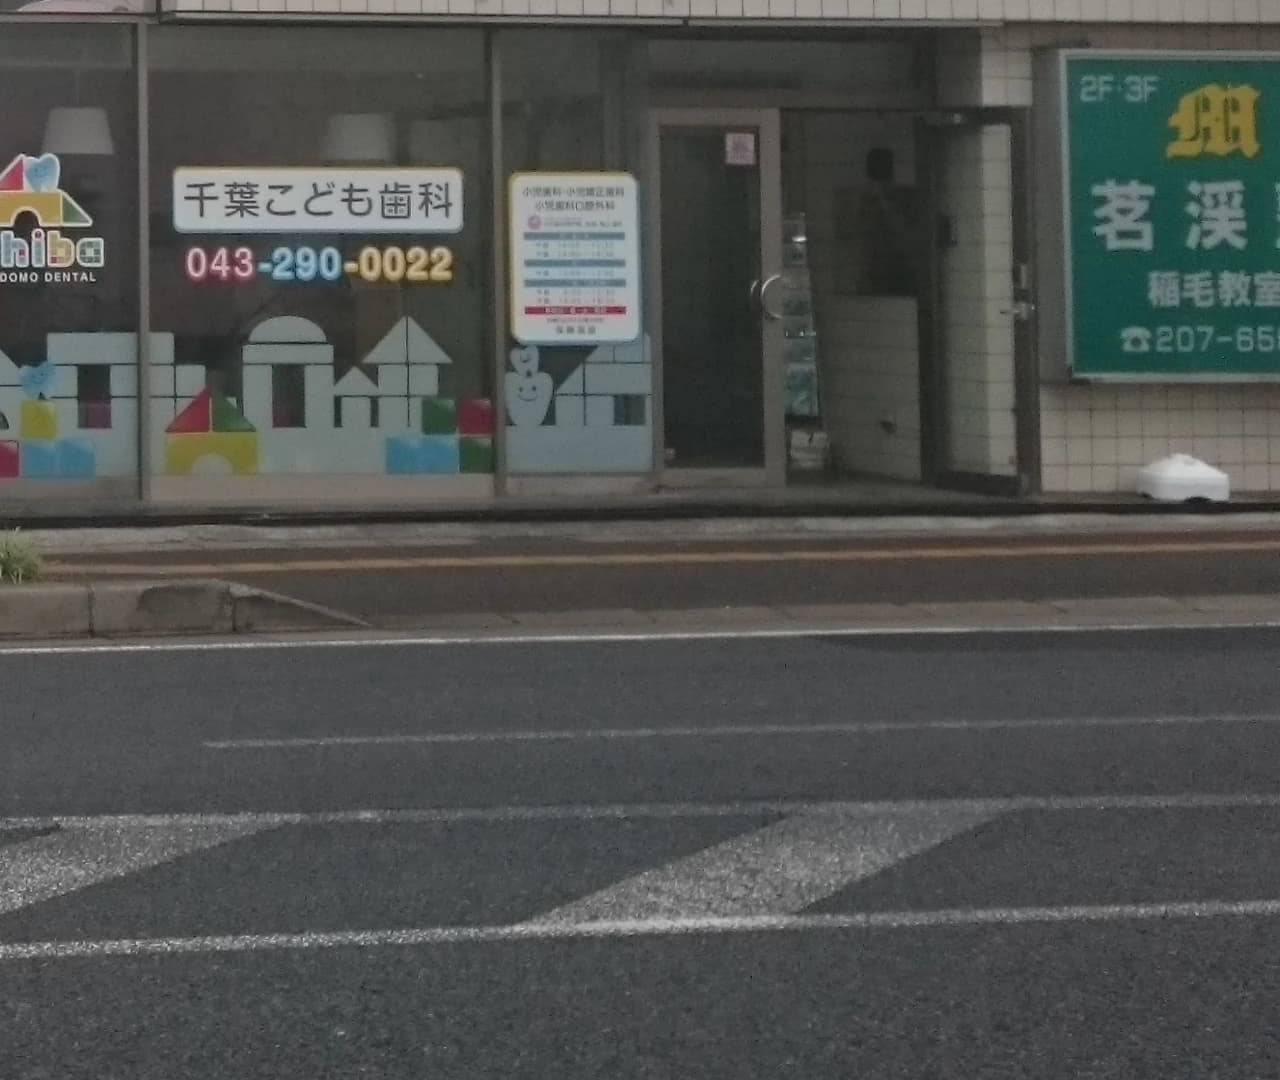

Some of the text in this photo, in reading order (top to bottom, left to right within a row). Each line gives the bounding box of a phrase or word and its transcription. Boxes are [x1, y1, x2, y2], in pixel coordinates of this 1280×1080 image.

[182, 180, 455, 221] 千葉こども歯科
[44, 271, 97, 283] DENTAL
[185, 244, 455, 282] 043-290-0022
[1155, 325, 1280, 353] 207-65
